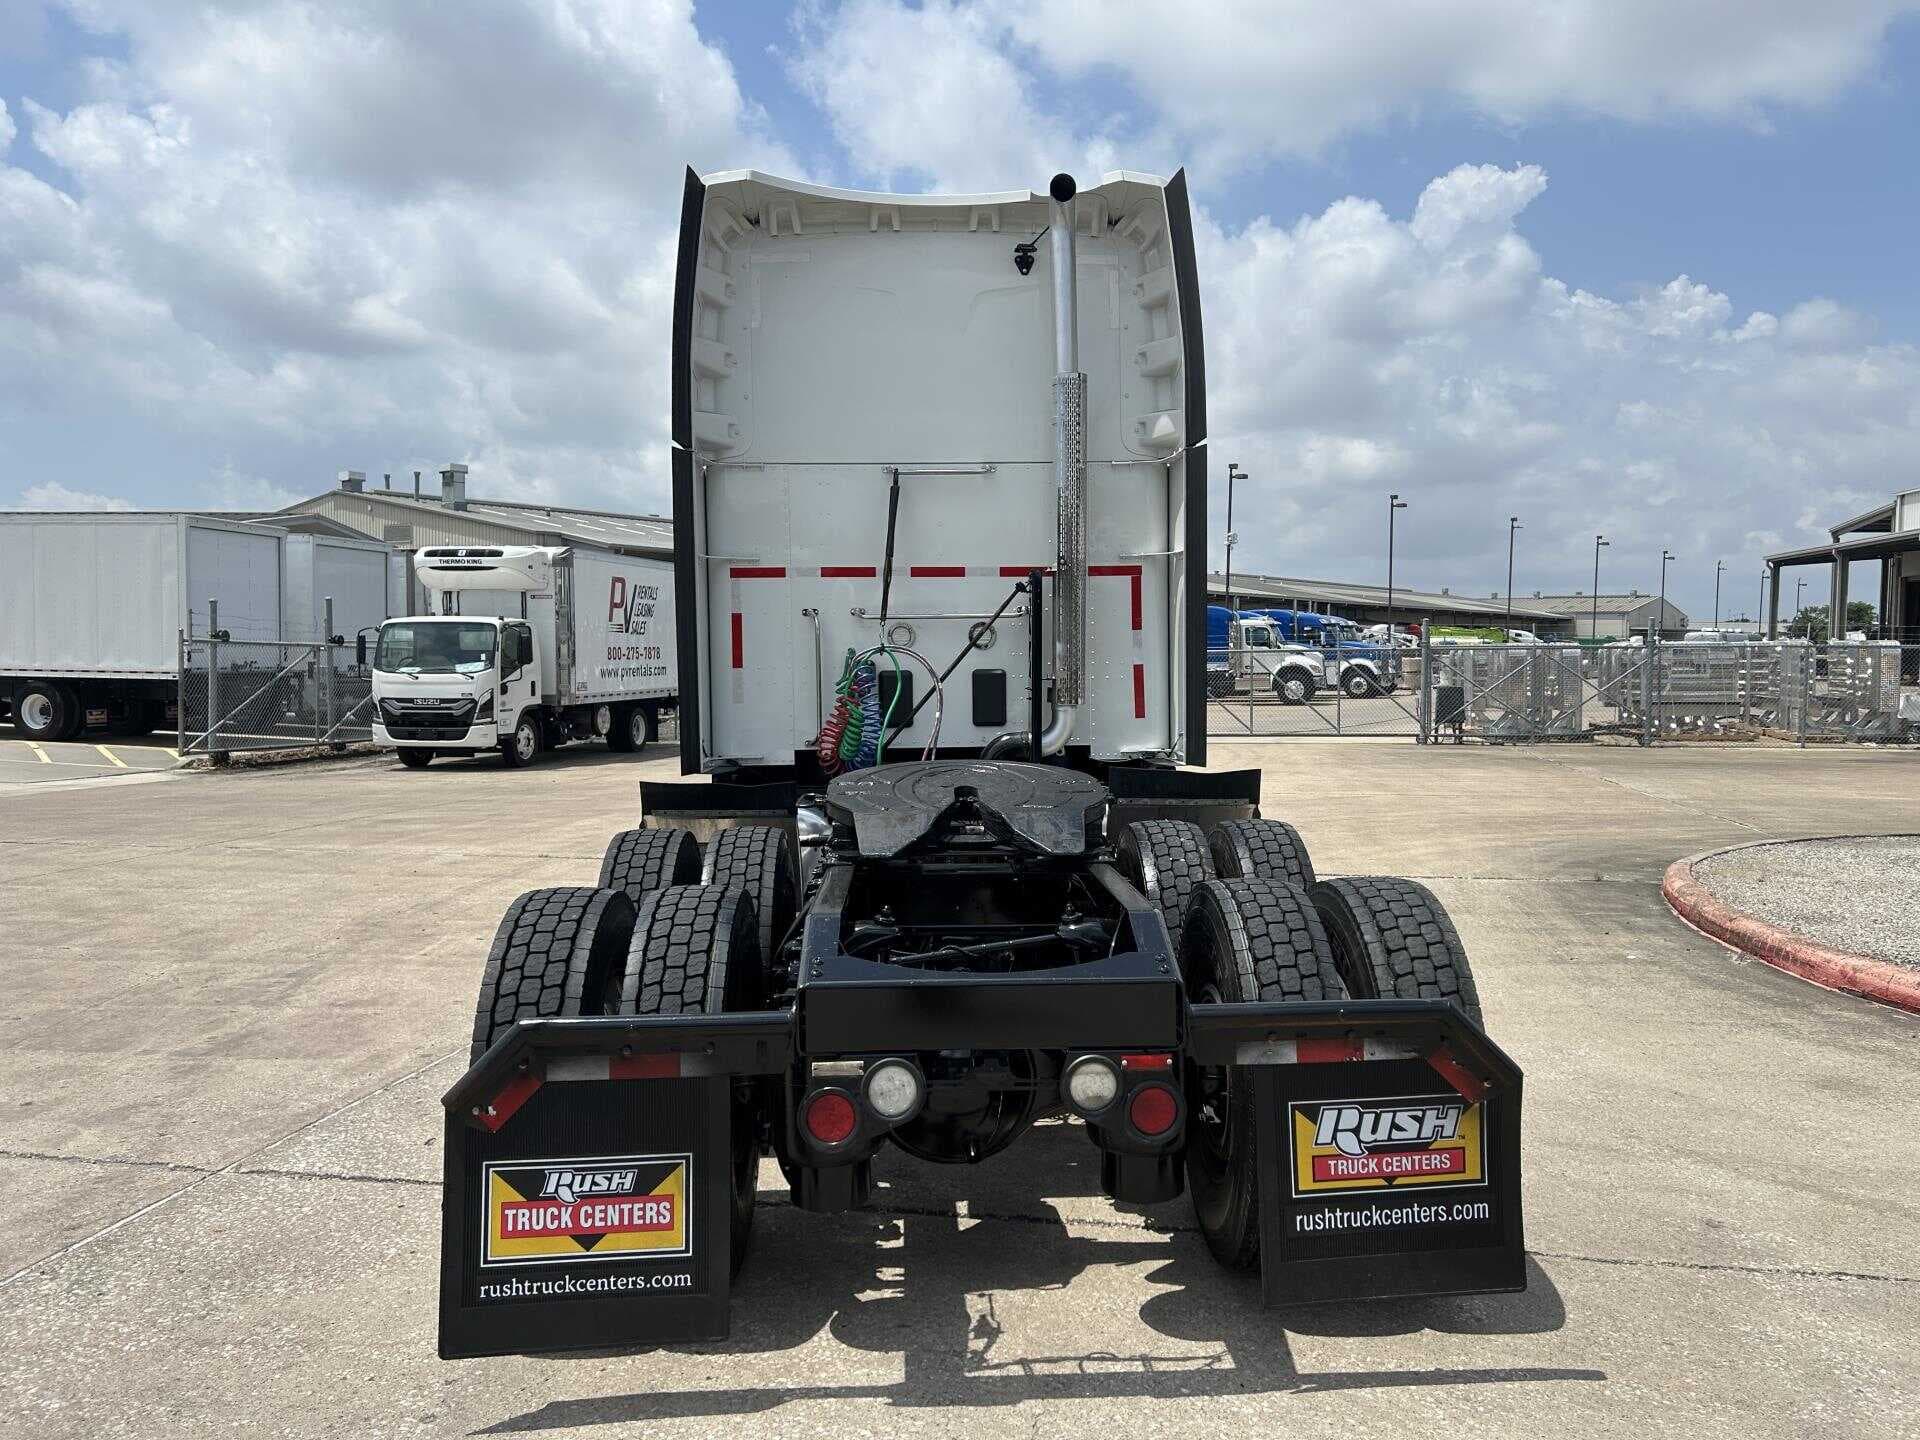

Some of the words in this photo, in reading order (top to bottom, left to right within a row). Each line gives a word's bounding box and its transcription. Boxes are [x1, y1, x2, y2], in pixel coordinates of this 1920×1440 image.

[637, 585, 658, 601] RENTALS
[633, 602, 655, 618] LEASING
[630, 620, 647, 636] SALES
[607, 646, 661, 661] 800-275-7878
[600, 664, 667, 681] www.pvrentals.com
[1311, 1104, 1463, 1159] RUSH
[1328, 1157, 1379, 1176] TRUCK
[1382, 1153, 1451, 1173] CENTERS
[539, 1169, 638, 1205] RUSH
[505, 1205, 573, 1232] TRUCK
[579, 1201, 672, 1228] CENTERS
[1296, 1202, 1489, 1232] rushtruckcenters.com
[479, 1272, 692, 1298] rushtruckcenters.com
